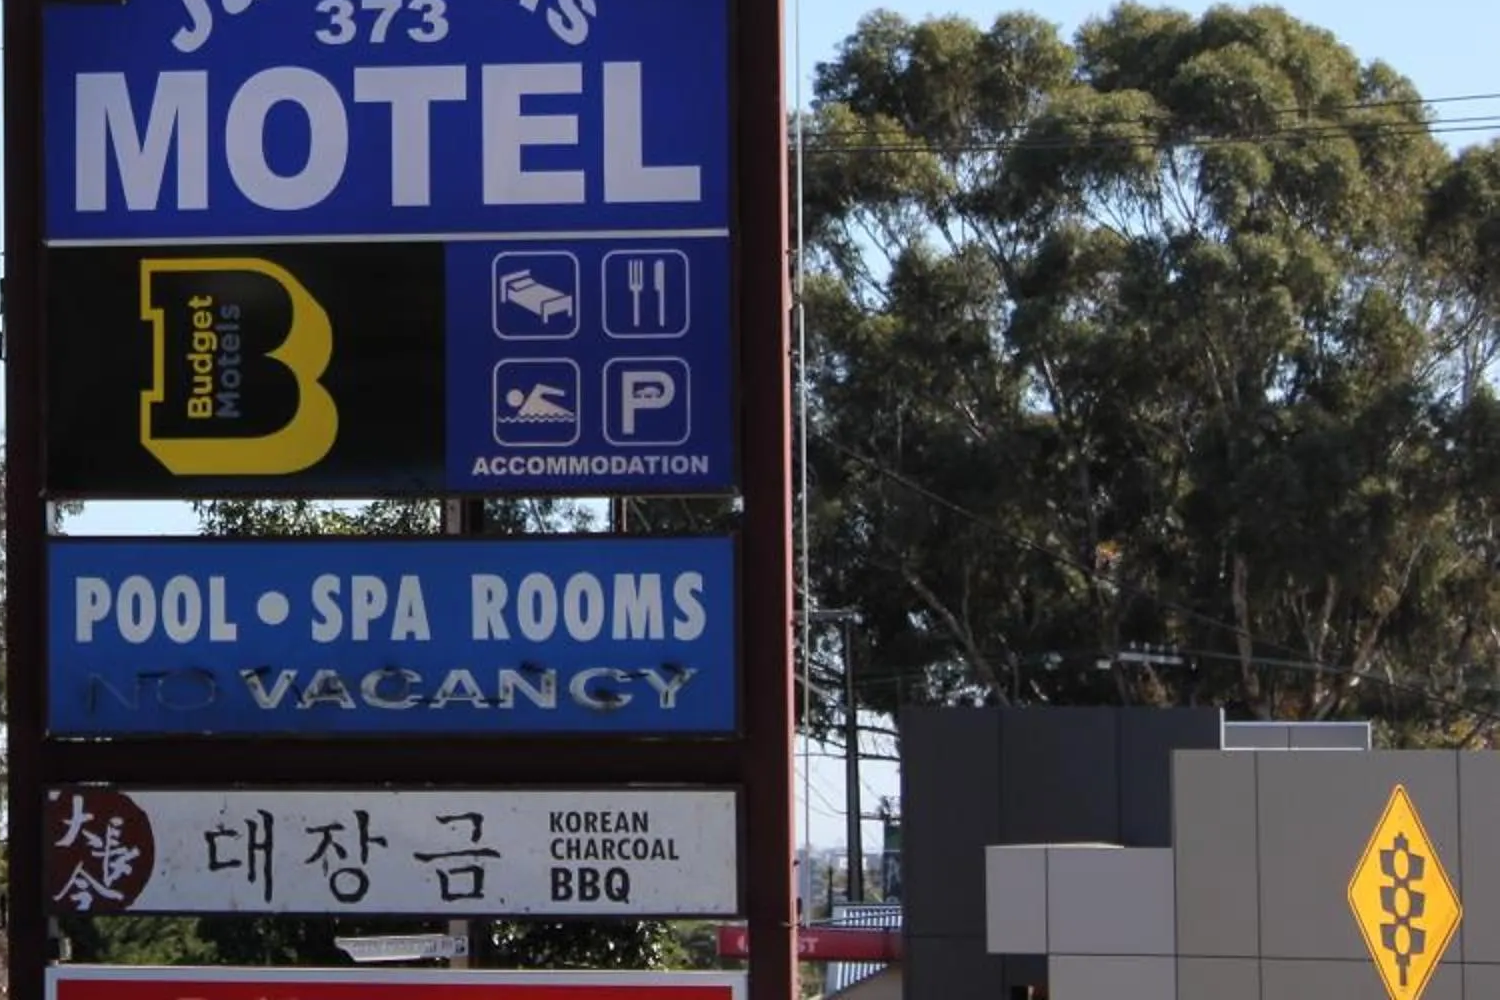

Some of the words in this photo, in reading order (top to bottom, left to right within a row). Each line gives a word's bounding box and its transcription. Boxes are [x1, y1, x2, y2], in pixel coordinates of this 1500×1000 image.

[74, 60, 701, 213] MOTEL
[186, 295, 217, 419] Budget
[216, 304, 242, 419] Motels
[471, 455, 709, 476] ACCOMMODATION
[75, 575, 238, 644] POOL
[310, 574, 432, 643] SPA
[471, 571, 707, 641] ROOMS
[239, 667, 697, 711] VACANCY
[549, 811, 649, 834] KOREAN
[550, 837, 680, 861] CHARCOAL
[204, 809, 501, 904] 대장금
[550, 867, 631, 904] BBQ
